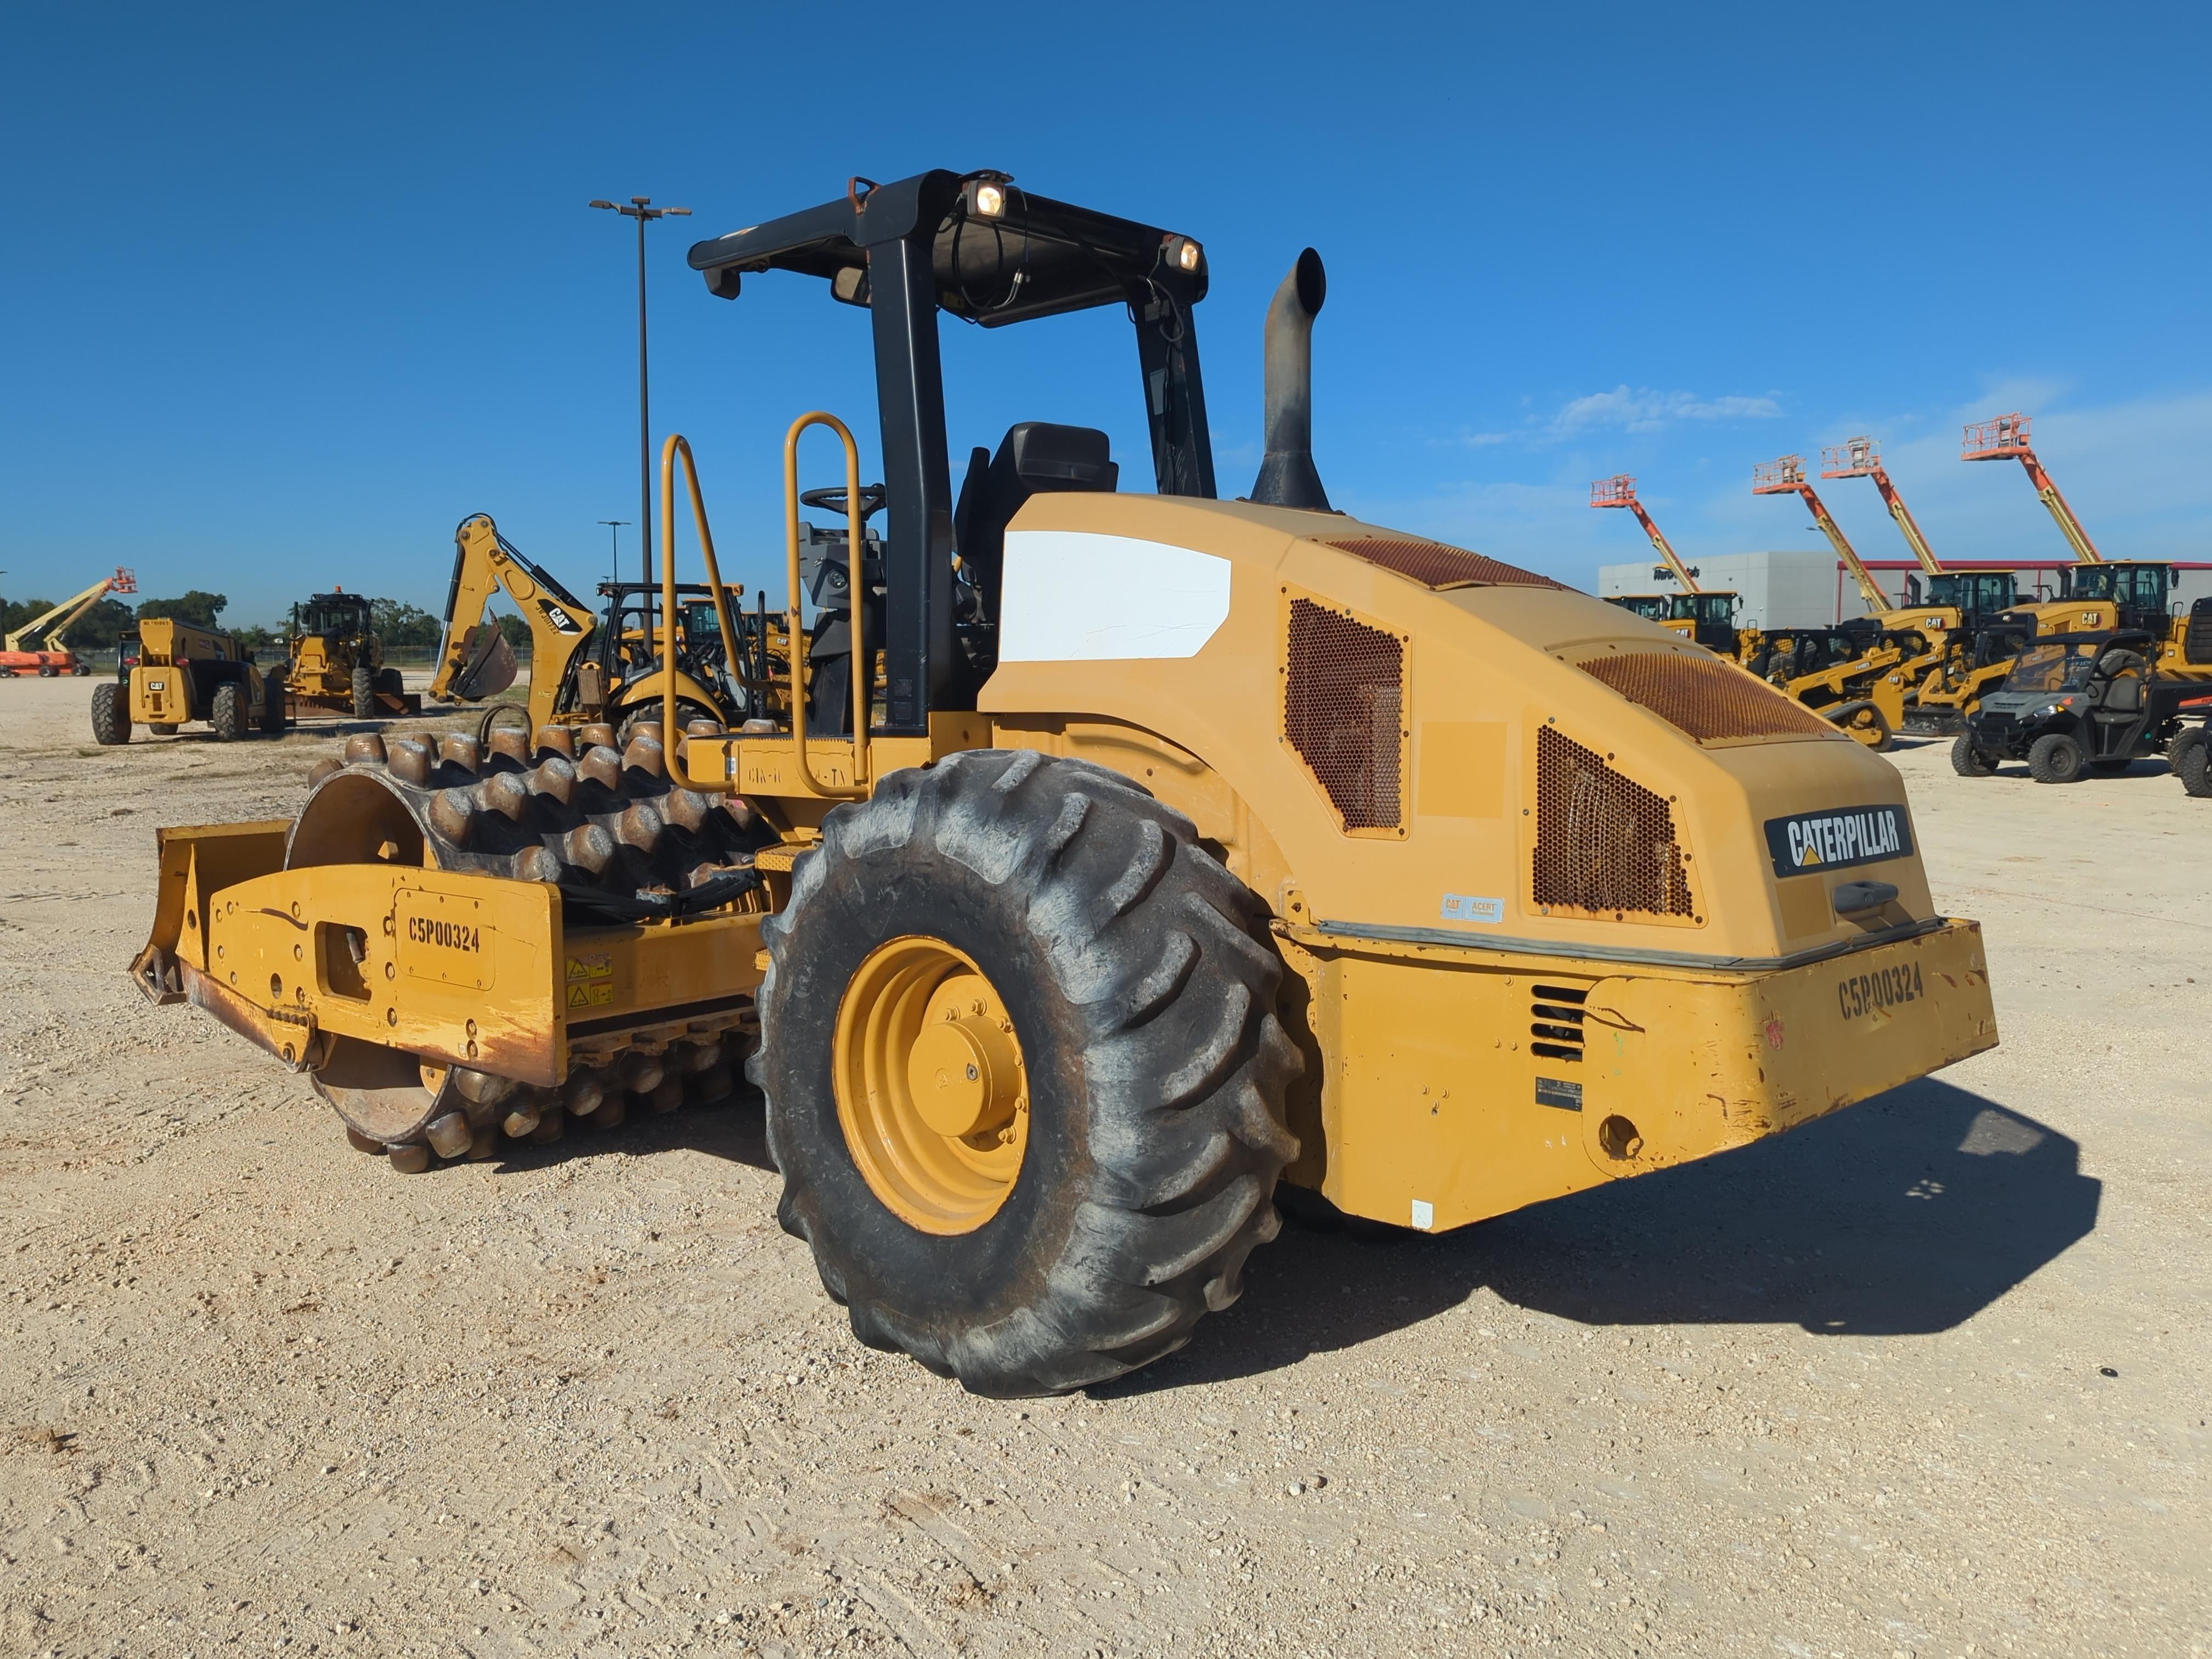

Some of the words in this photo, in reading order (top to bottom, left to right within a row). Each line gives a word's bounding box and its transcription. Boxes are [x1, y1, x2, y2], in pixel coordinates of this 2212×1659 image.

[549, 607, 570, 629] CAT
[1926, 618, 1942, 629] CAT
[2082, 613, 2098, 625] CAT
[1787, 810, 1900, 867] CATERPILLAR
[1446, 899, 1461, 910] CAT
[1471, 901, 1497, 911] ACERT
[409, 917, 479, 953] C5P00324
[1839, 961, 1923, 1020] C5P00324
